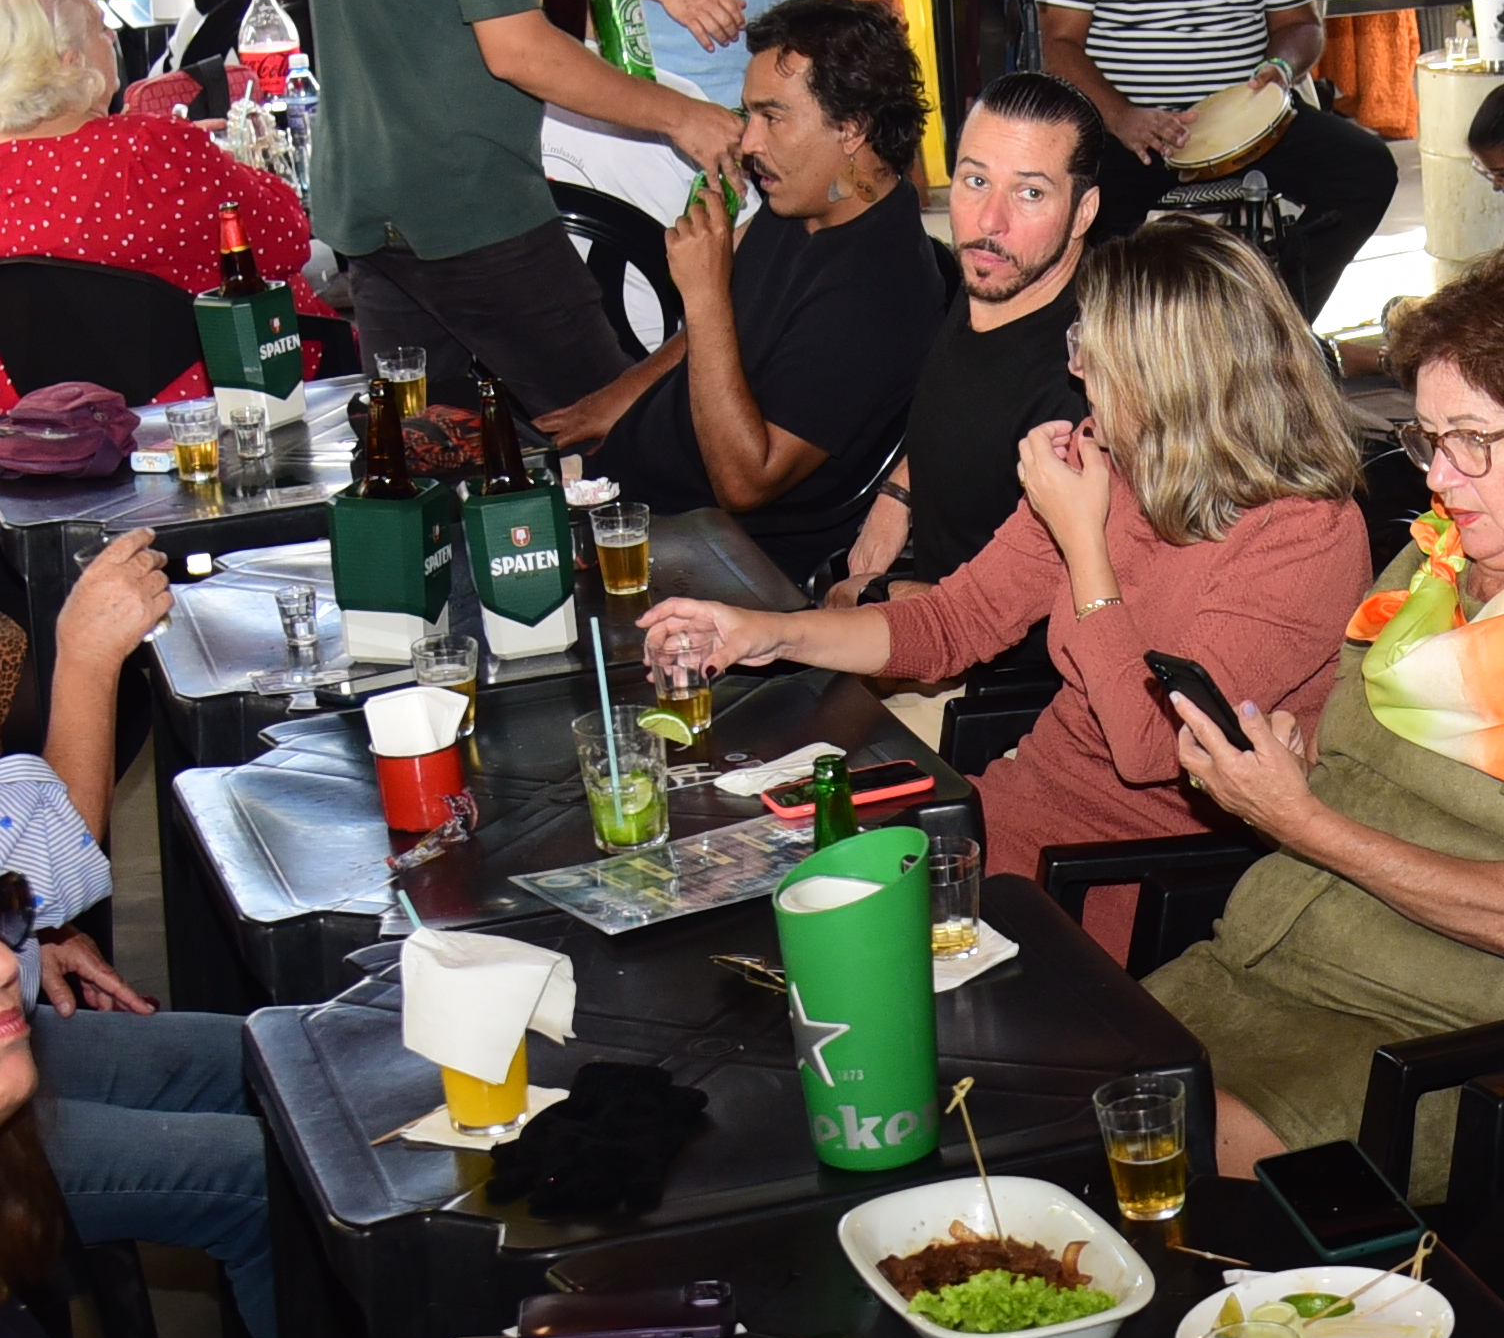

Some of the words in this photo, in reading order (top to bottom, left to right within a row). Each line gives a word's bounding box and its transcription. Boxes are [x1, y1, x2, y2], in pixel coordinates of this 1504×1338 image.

[259, 333, 302, 361] SPATEN
[424, 543, 453, 577] SPATEN
[490, 549, 560, 577] SPATEN
